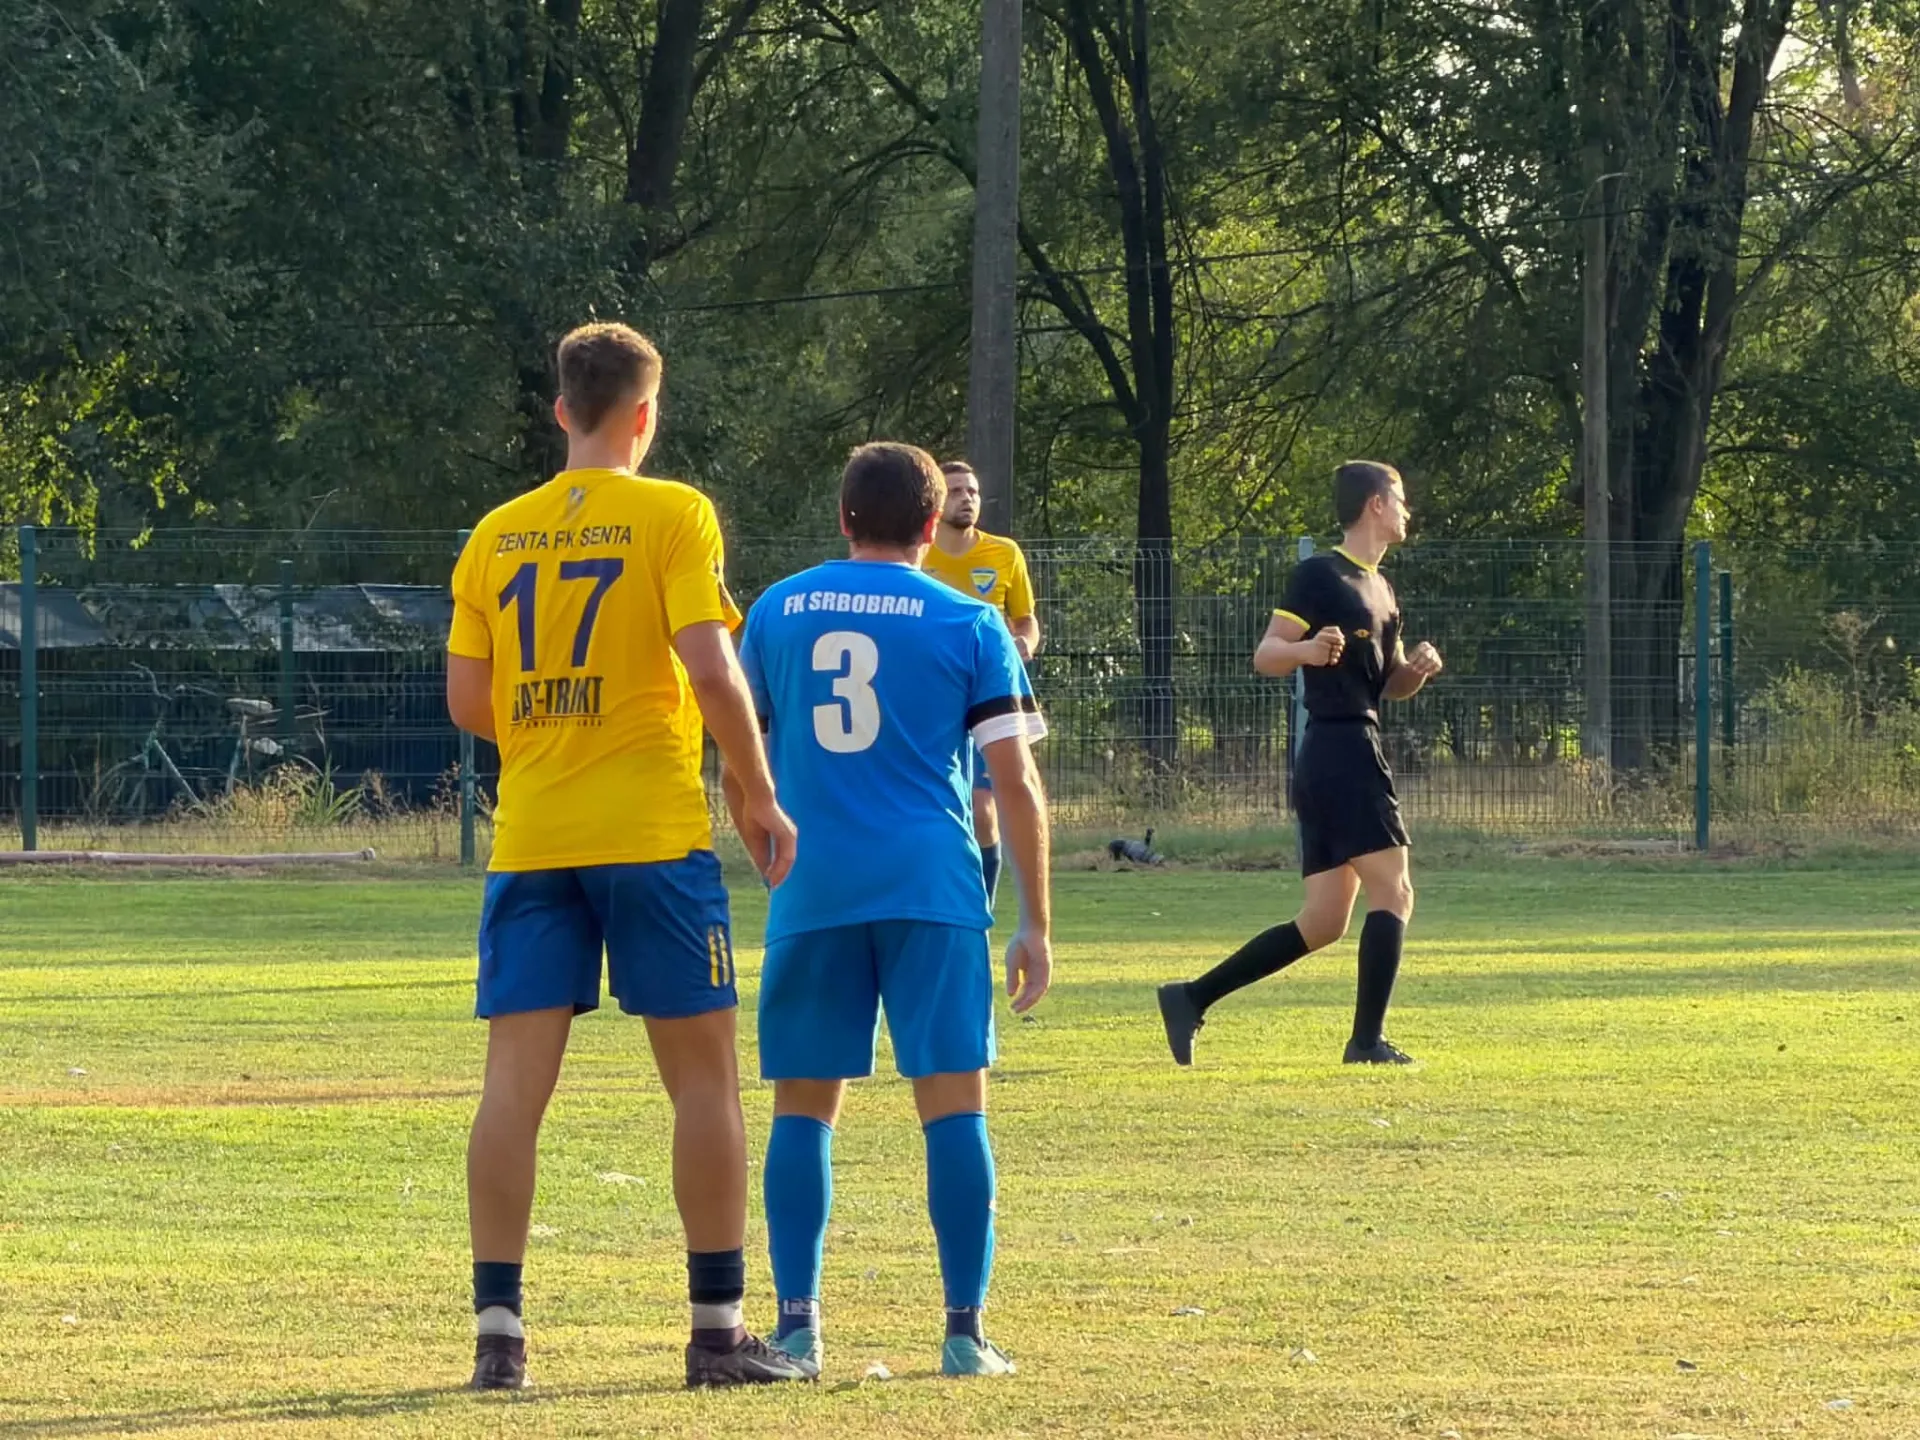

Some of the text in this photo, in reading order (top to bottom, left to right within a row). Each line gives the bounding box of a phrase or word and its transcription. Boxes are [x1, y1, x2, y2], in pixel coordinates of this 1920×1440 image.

[496, 525, 632, 553] ZENTA FK SENTA
[498, 557, 625, 672] 17
[783, 590, 925, 618] FK SRBOBRAN
[812, 631, 881, 753] 3
